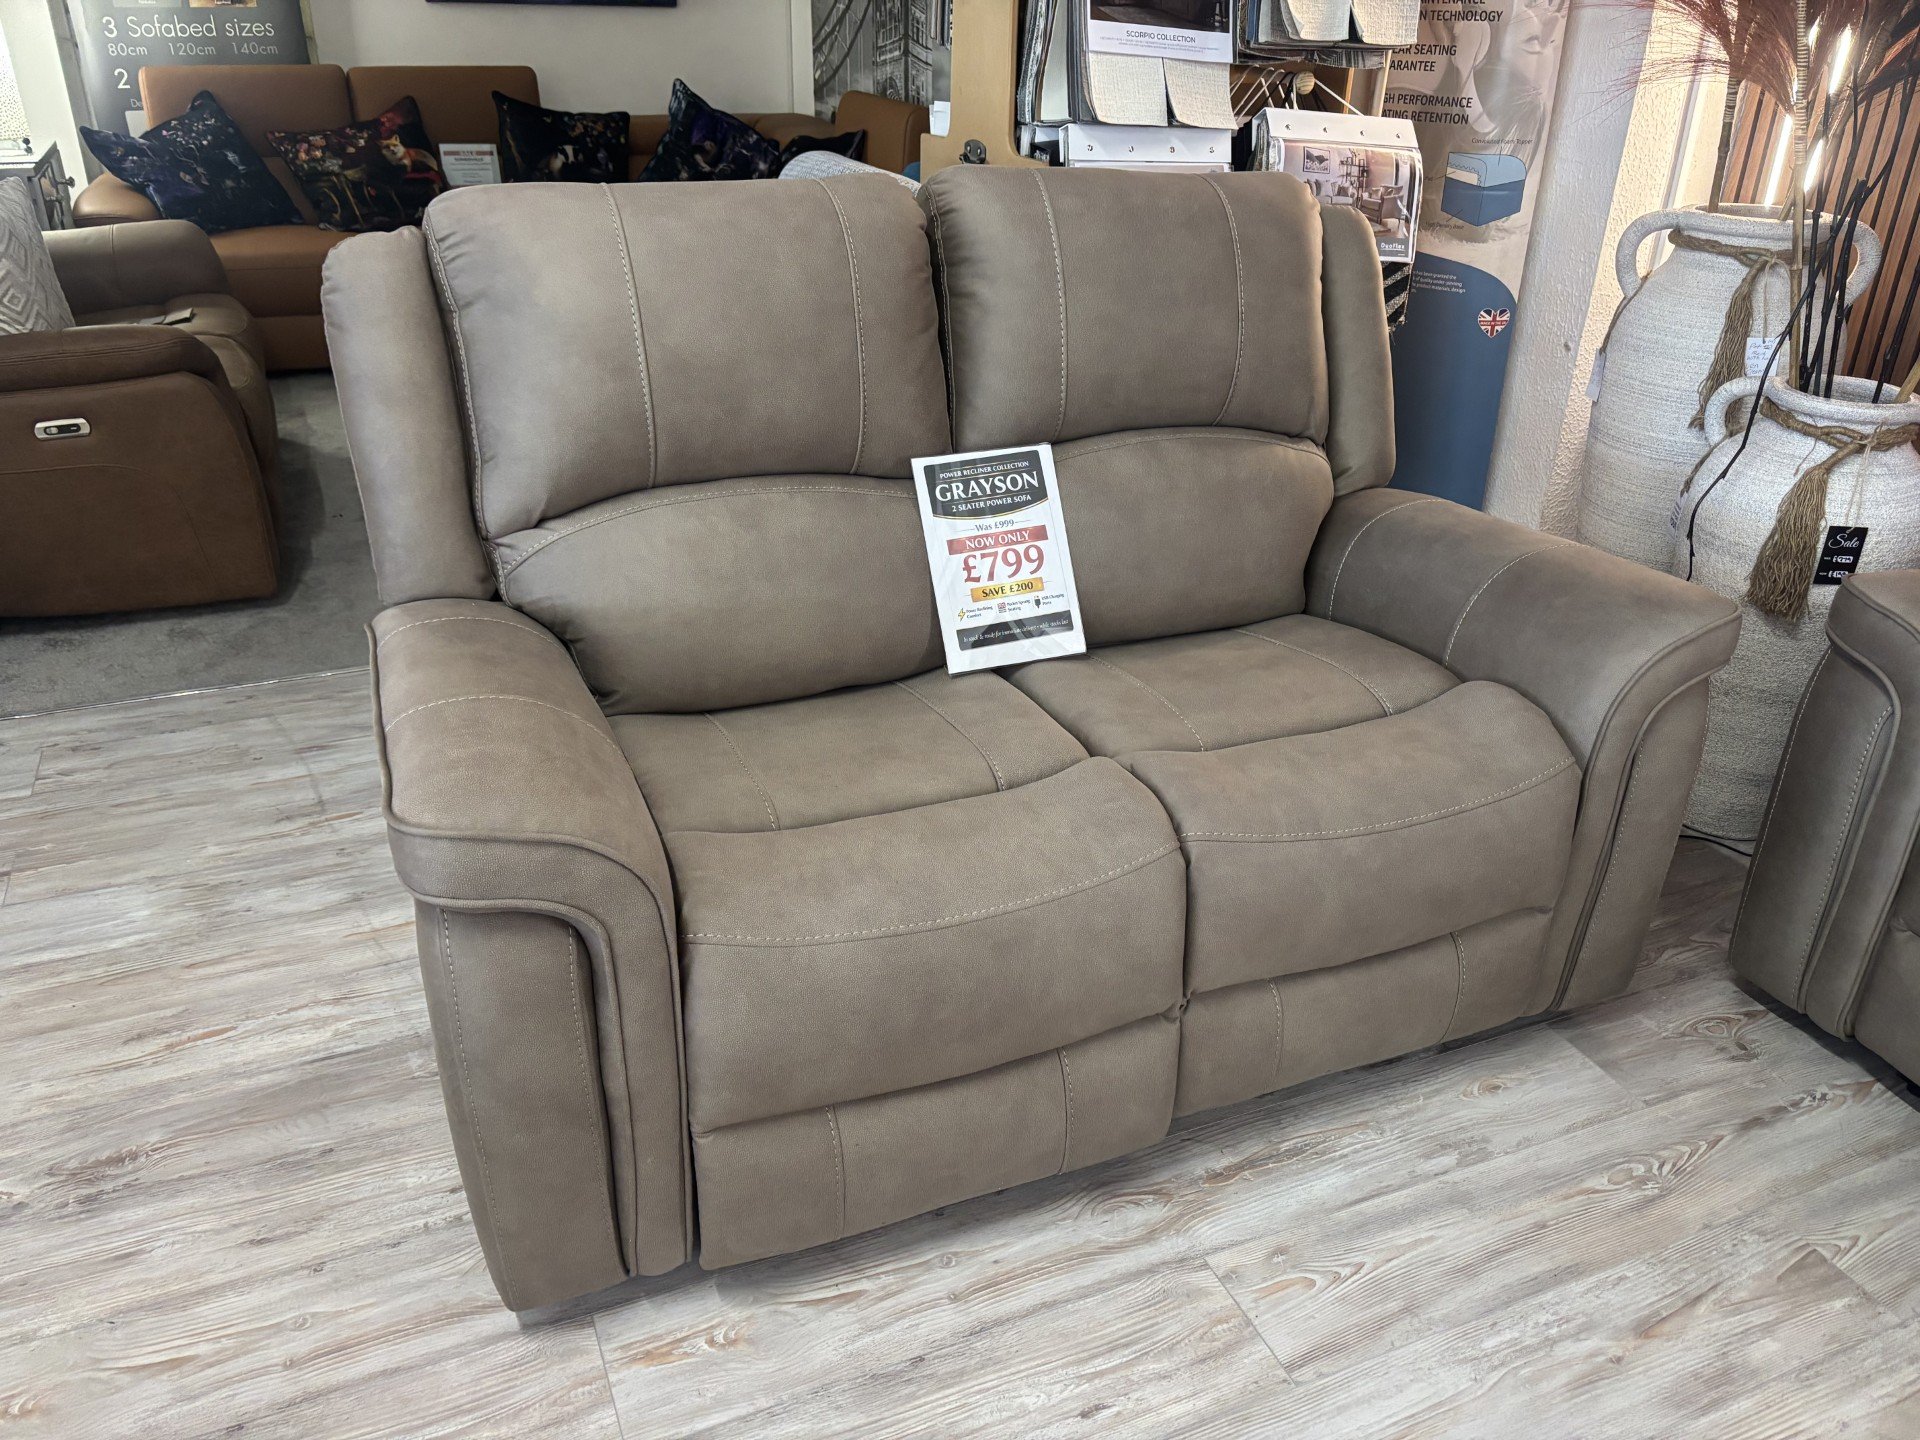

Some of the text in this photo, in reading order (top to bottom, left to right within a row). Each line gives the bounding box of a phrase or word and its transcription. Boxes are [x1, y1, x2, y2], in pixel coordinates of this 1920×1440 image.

[1430, 10, 1503, 22] TECHNOLOGY
[102, 14, 275, 38] 3 Sofabed sizes
[1126, 30, 1196, 43] SCORPIO COLLECTION
[107, 42, 279, 57] 80cm 120cm 140cm
[1414, 44, 1457, 56] SEATING
[1389, 59, 1436, 72] ARANTEE
[113, 68, 131, 89] 2
[1383, 92, 1473, 108] GH PERFORMANCE
[1381, 109, 1469, 125] ATING RETENTION
[940, 461, 1030, 479] POWER RECLINER COLLECTION
[935, 470, 1039, 502] GRAYSON
[958, 501, 985, 512] SEATER
[986, 498, 1012, 507] POWER
[1013, 494, 1032, 503] SOFA
[975, 519, 1015, 532] Was £999
[965, 530, 1030, 550] NOW ONLY
[1828, 533, 1860, 549] Sale
[962, 544, 1045, 583] £799
[981, 581, 1034, 598] SAVE £200
